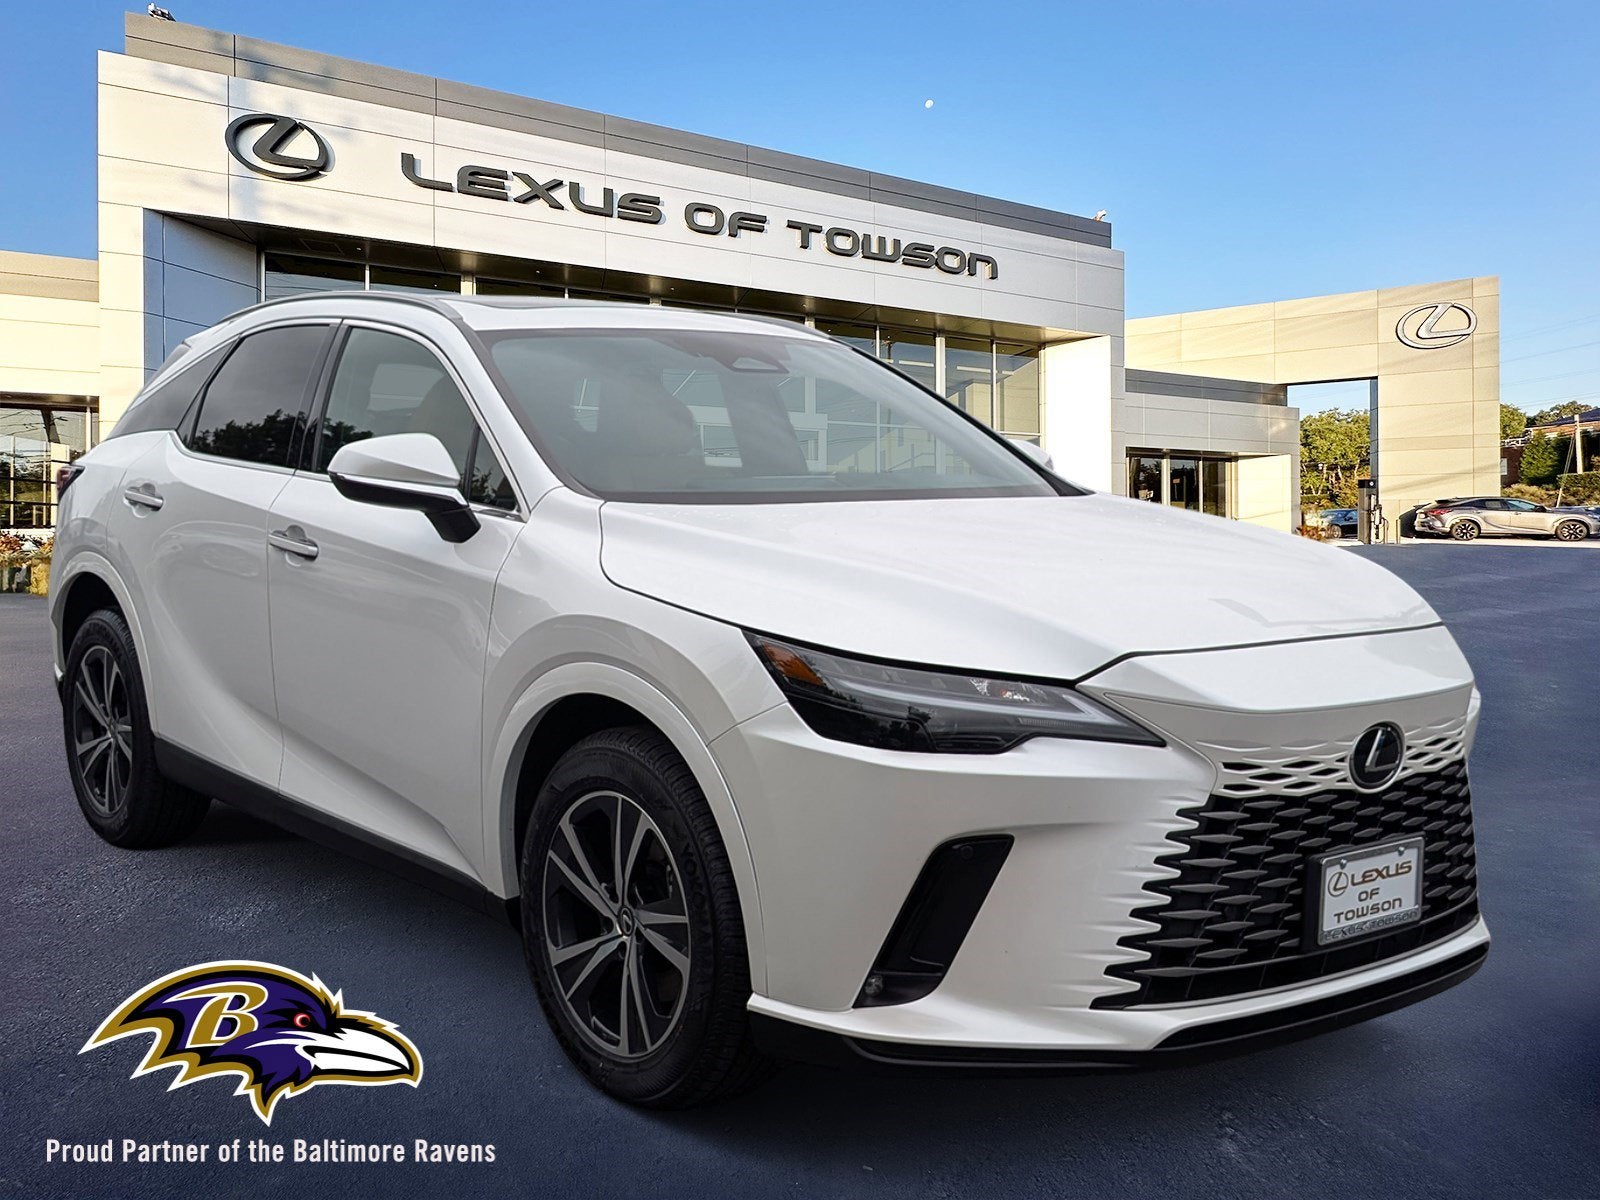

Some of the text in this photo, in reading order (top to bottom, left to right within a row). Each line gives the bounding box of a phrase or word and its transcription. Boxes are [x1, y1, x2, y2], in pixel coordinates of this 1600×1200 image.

[401, 153, 999, 281] LEXUS OF TOWSON
[1350, 860, 1412, 886] LEXUS
[1358, 887, 1380, 902] OF
[1334, 897, 1402, 924] TOWSON
